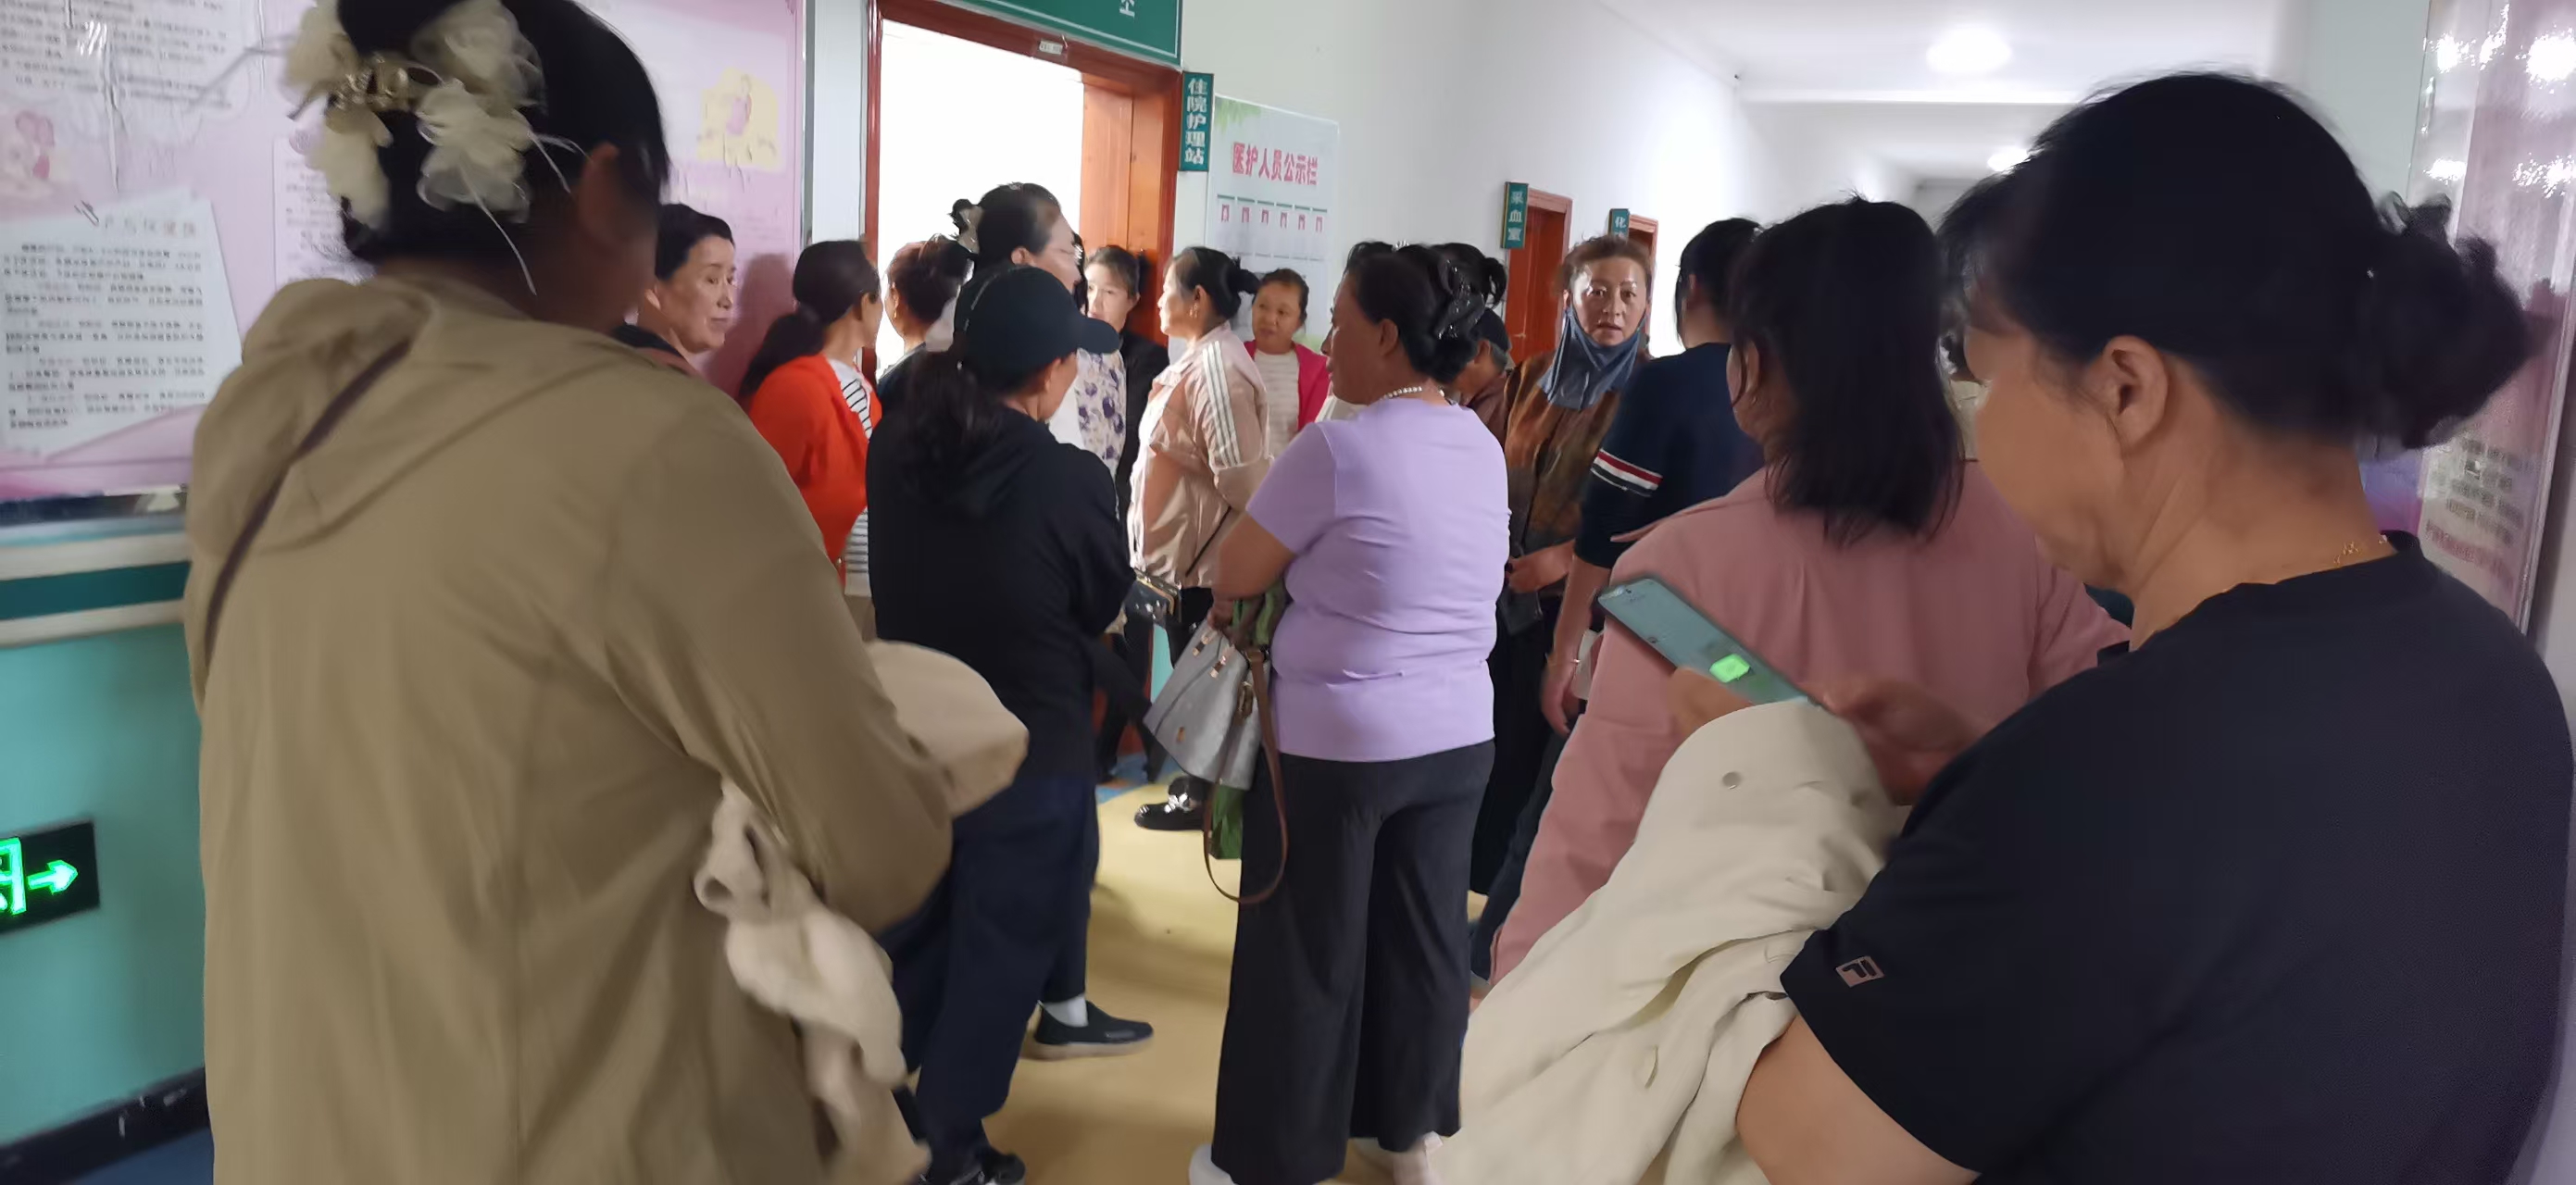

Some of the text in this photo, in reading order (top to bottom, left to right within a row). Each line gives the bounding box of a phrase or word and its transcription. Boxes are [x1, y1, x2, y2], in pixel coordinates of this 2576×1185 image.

[1184, 78, 1207, 165] 住院护理站
[1232, 142, 1318, 185] 医护人员公示栏
